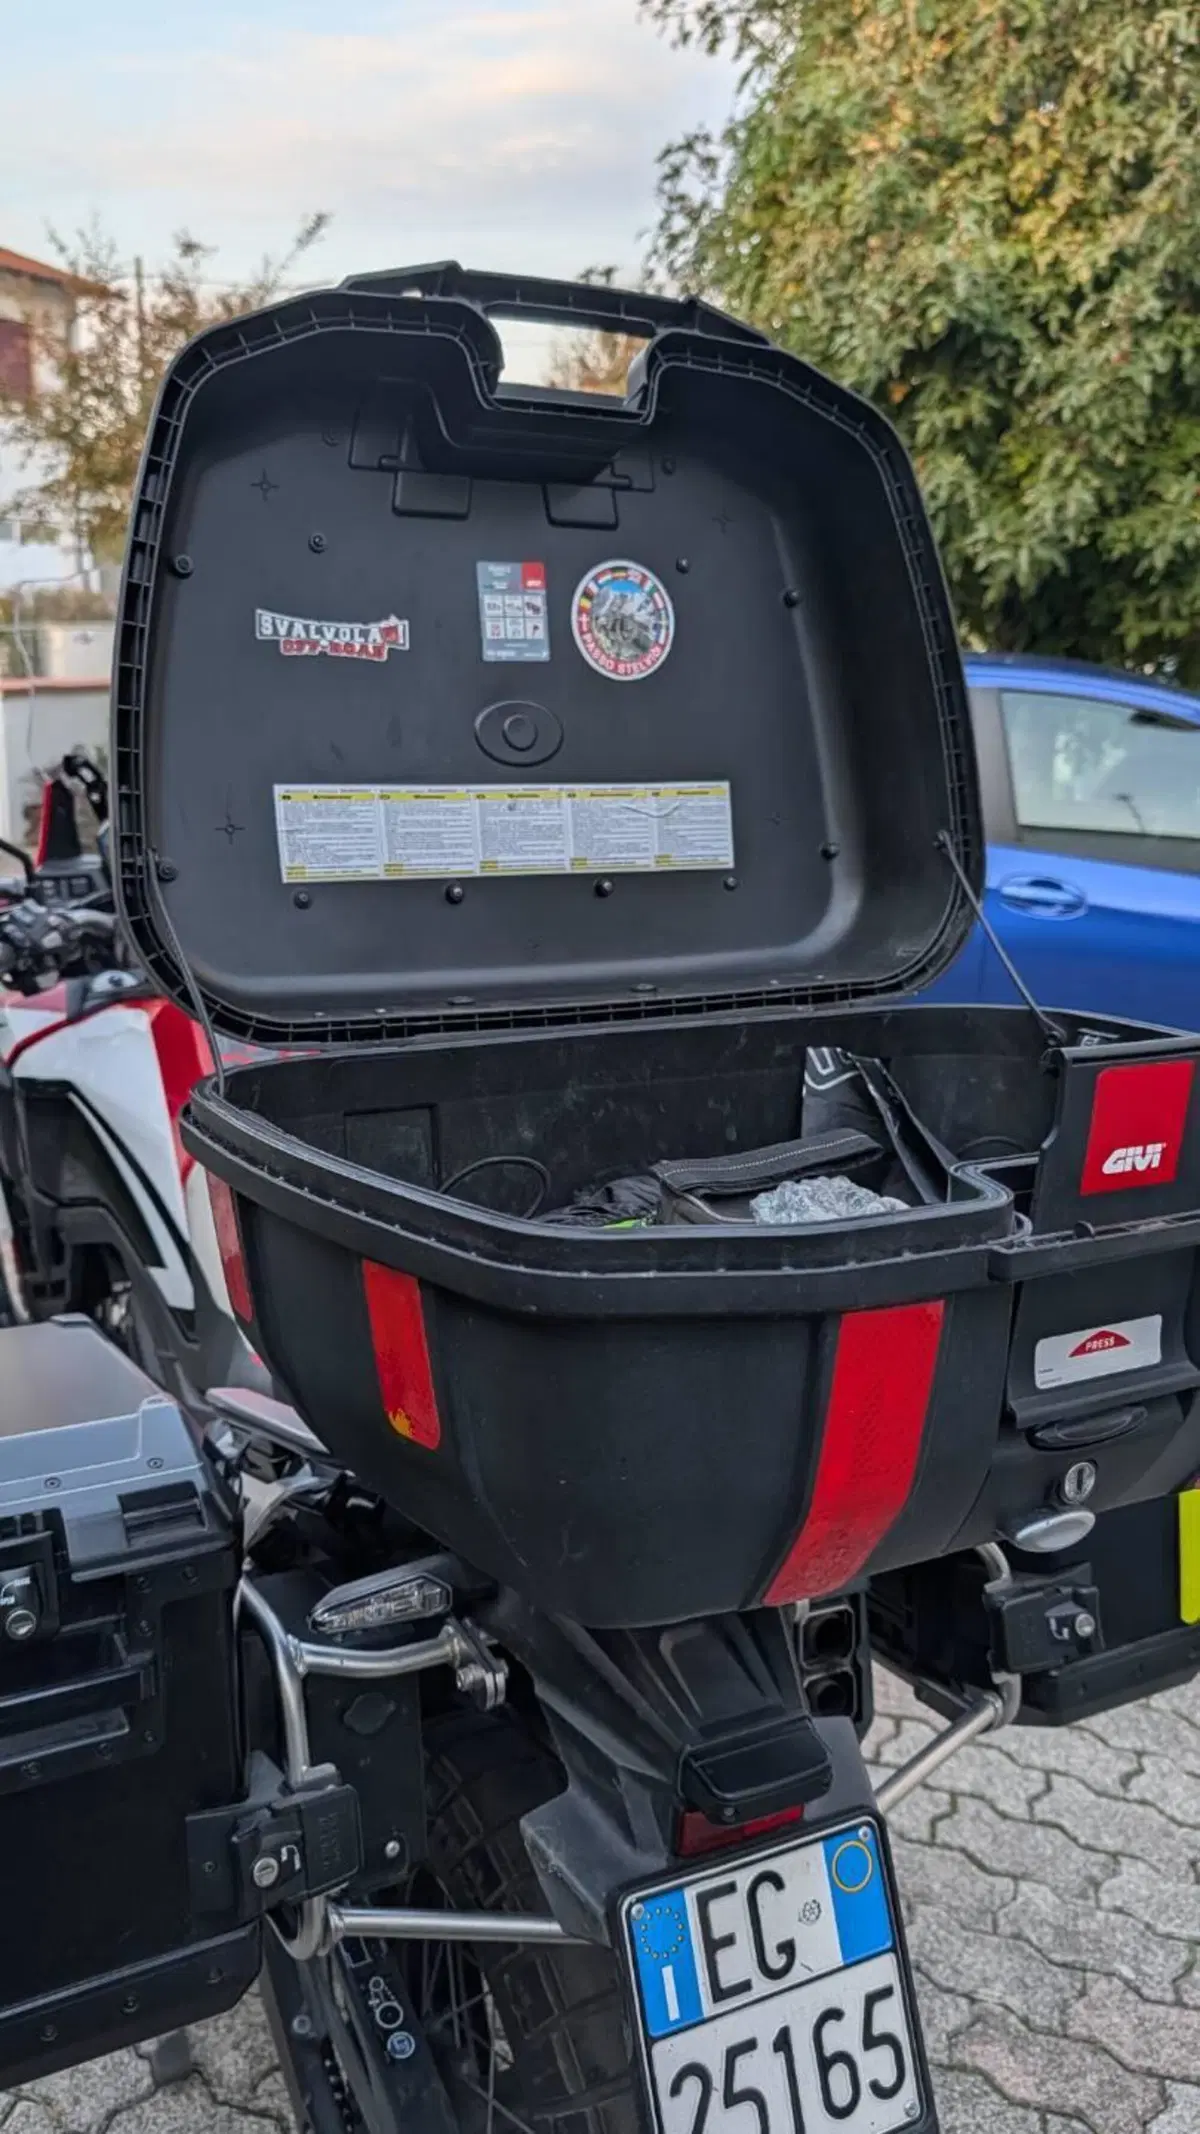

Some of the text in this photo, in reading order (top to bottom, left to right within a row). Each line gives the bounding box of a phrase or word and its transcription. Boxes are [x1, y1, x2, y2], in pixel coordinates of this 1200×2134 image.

[259, 613, 406, 645] SVALVOLAI
[1102, 1143, 1164, 1175] GIVI
[1084, 1336, 1116, 1352] PRESS
[694, 1869, 796, 2005] EG
[669, 1983, 906, 2134] 25165
